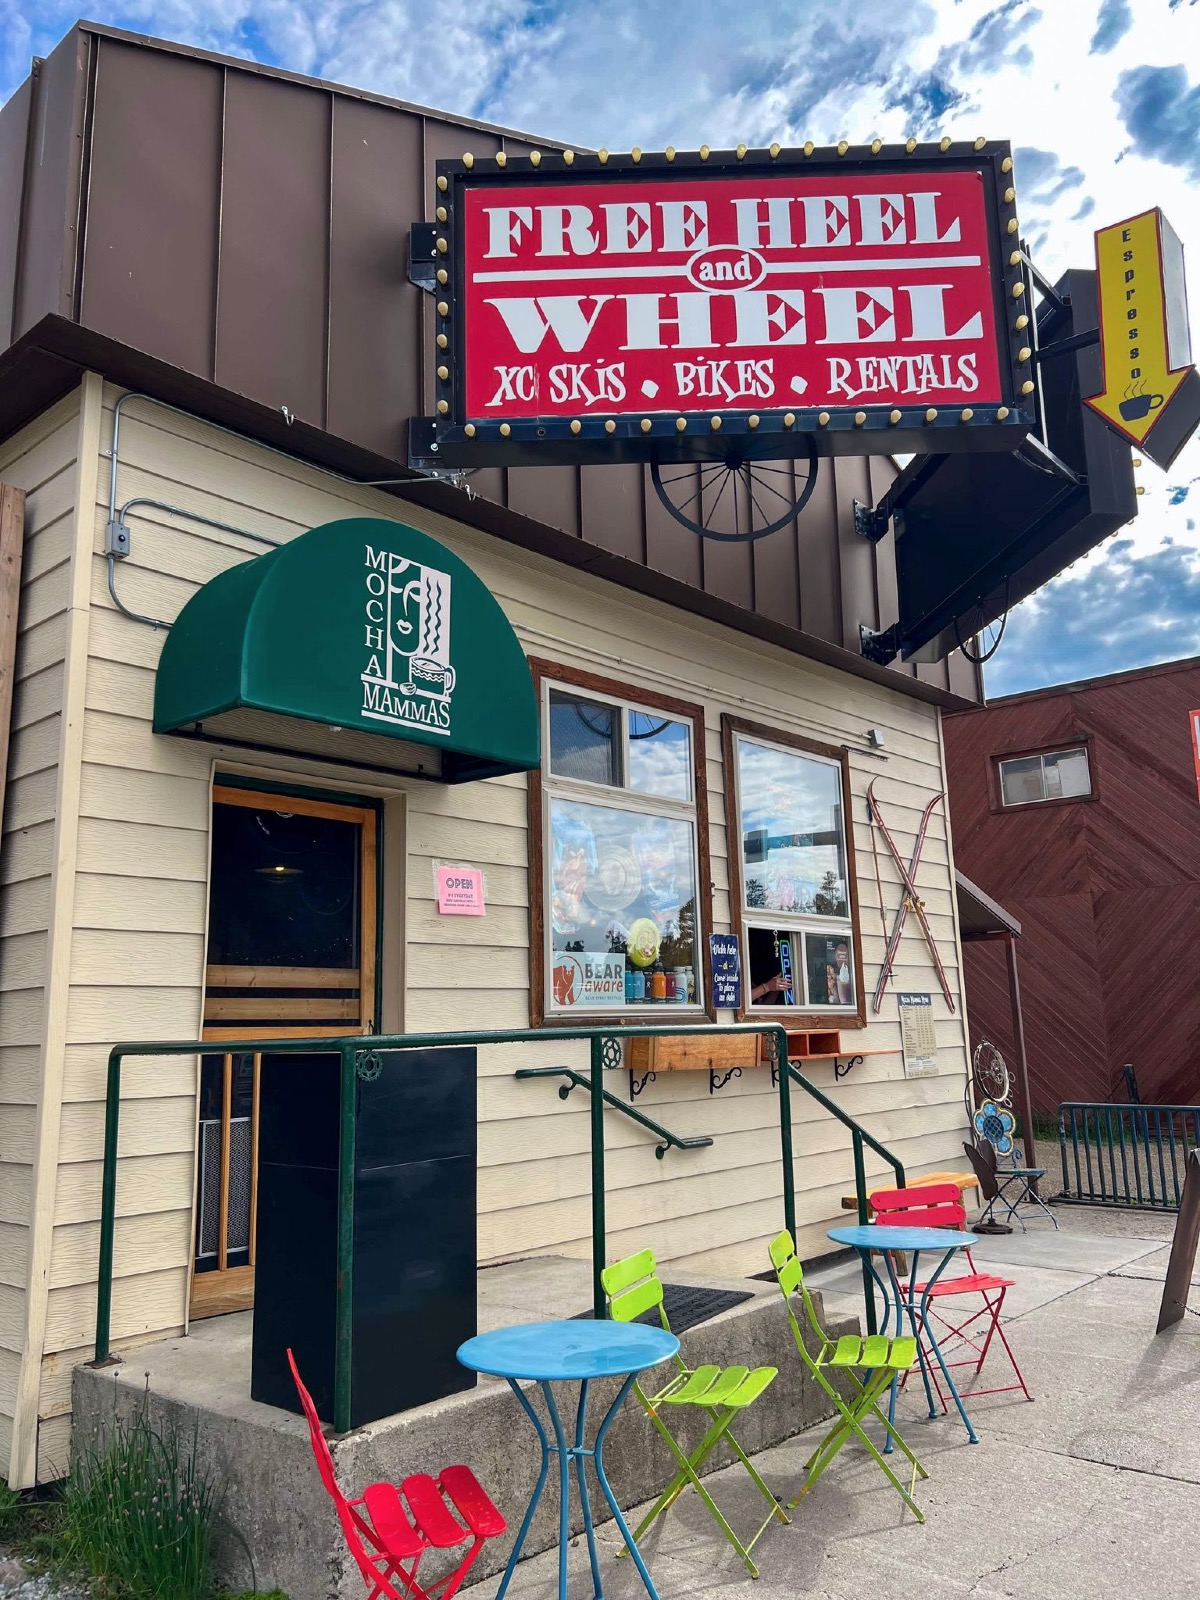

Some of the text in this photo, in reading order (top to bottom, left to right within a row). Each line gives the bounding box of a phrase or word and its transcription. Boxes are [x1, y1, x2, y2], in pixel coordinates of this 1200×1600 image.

[482, 192, 961, 258] FREE HEEL
[699, 254, 752, 281] and
[483, 284, 984, 354] WHEEL
[1122, 228, 1141, 379] Espresso
[485, 366, 535, 407] XC
[826, 353, 979, 400] RENTALS
[364, 544, 388, 678] MOCHA
[362, 682, 451, 728] MAMMAS
[445, 877, 474, 890] OPEN
[585, 963, 622, 980] BEAR
[585, 980, 623, 993] aware
